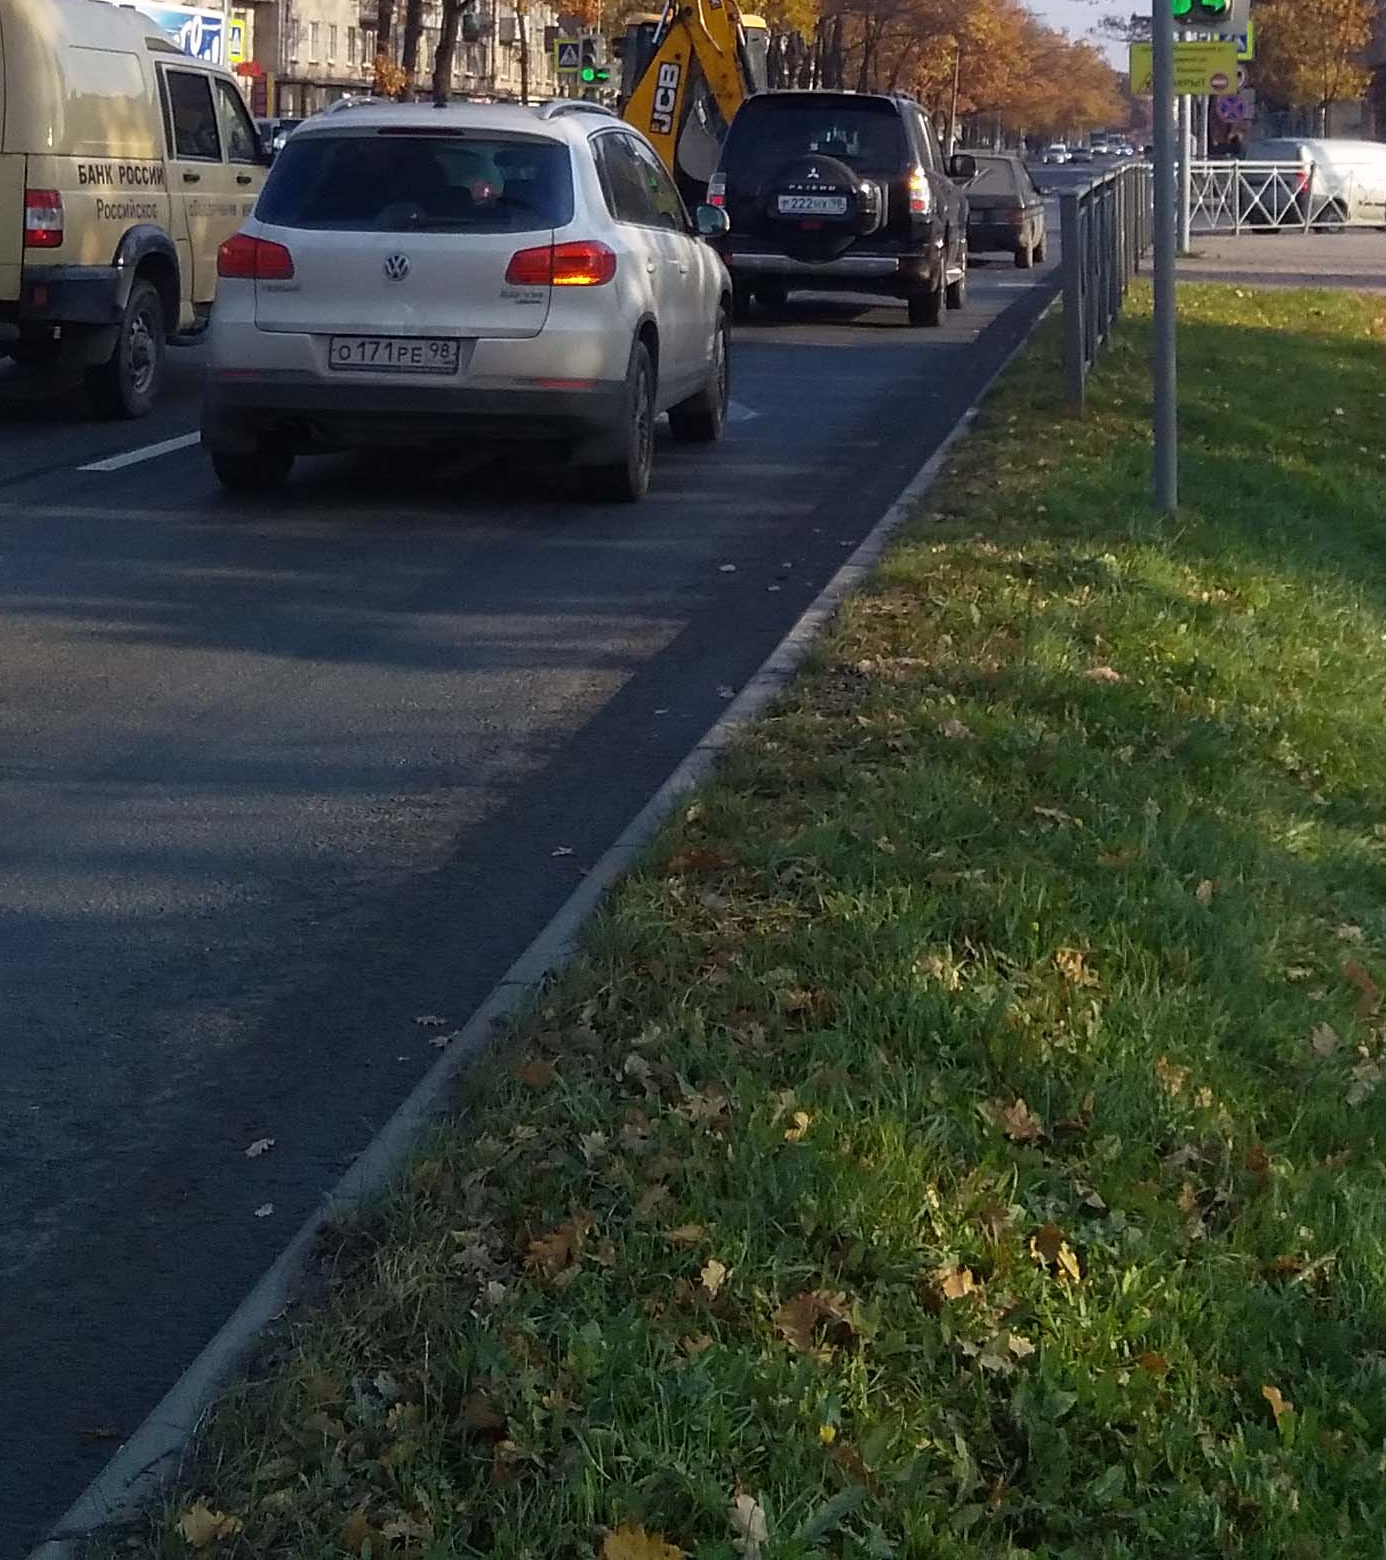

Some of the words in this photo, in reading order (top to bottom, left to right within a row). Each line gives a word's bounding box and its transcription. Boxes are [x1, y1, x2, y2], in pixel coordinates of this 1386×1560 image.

[650, 63, 680, 133] JCB
[78, 164, 113, 185] БАНК
[118, 165, 165, 185] РОССИИ
[96, 198, 158, 220] Российское
